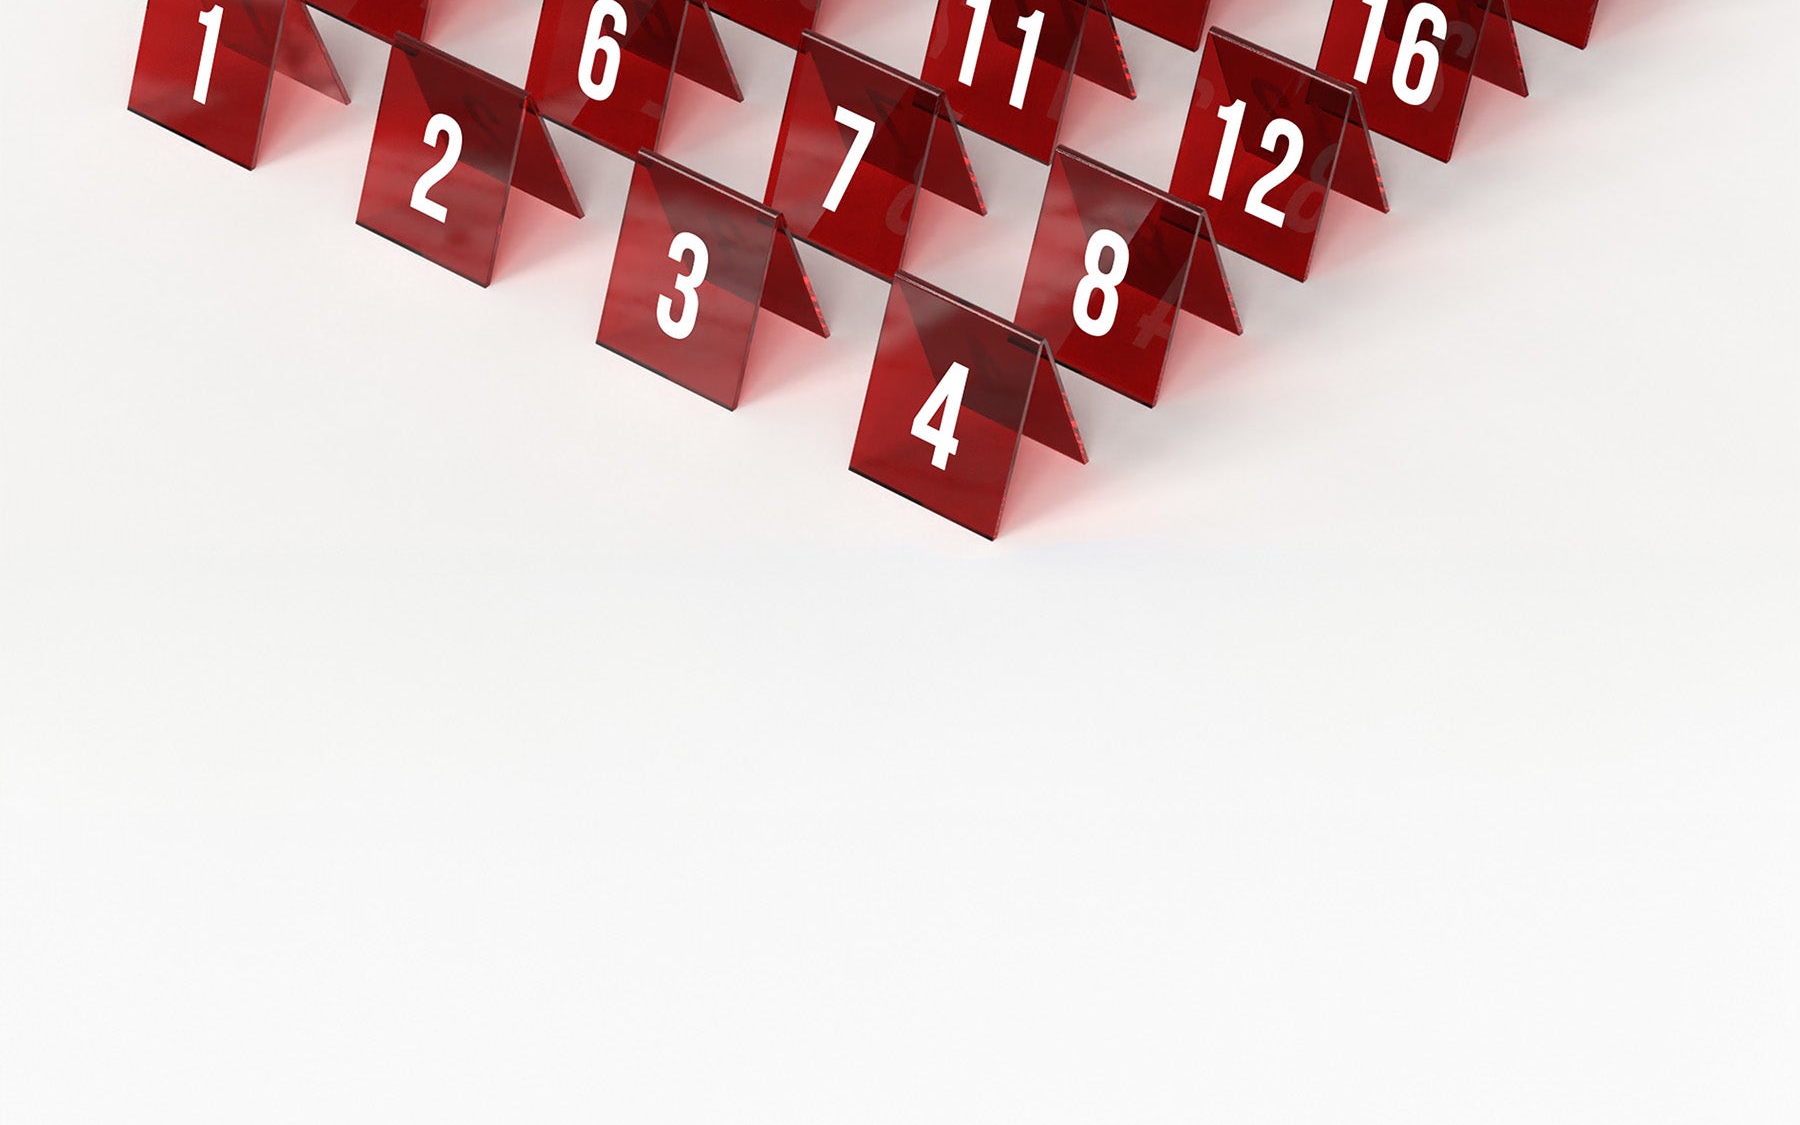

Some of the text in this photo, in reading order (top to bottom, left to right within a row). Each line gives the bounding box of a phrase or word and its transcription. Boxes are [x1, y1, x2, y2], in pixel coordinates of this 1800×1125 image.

[192, 4, 224, 105] 1
[409, 113, 463, 224] 2
[822, 105, 876, 213] 7
[1208, 98, 1304, 228] 12
[656, 231, 709, 340] 3
[1072, 228, 1130, 337] 8
[910, 361, 970, 471] 4
